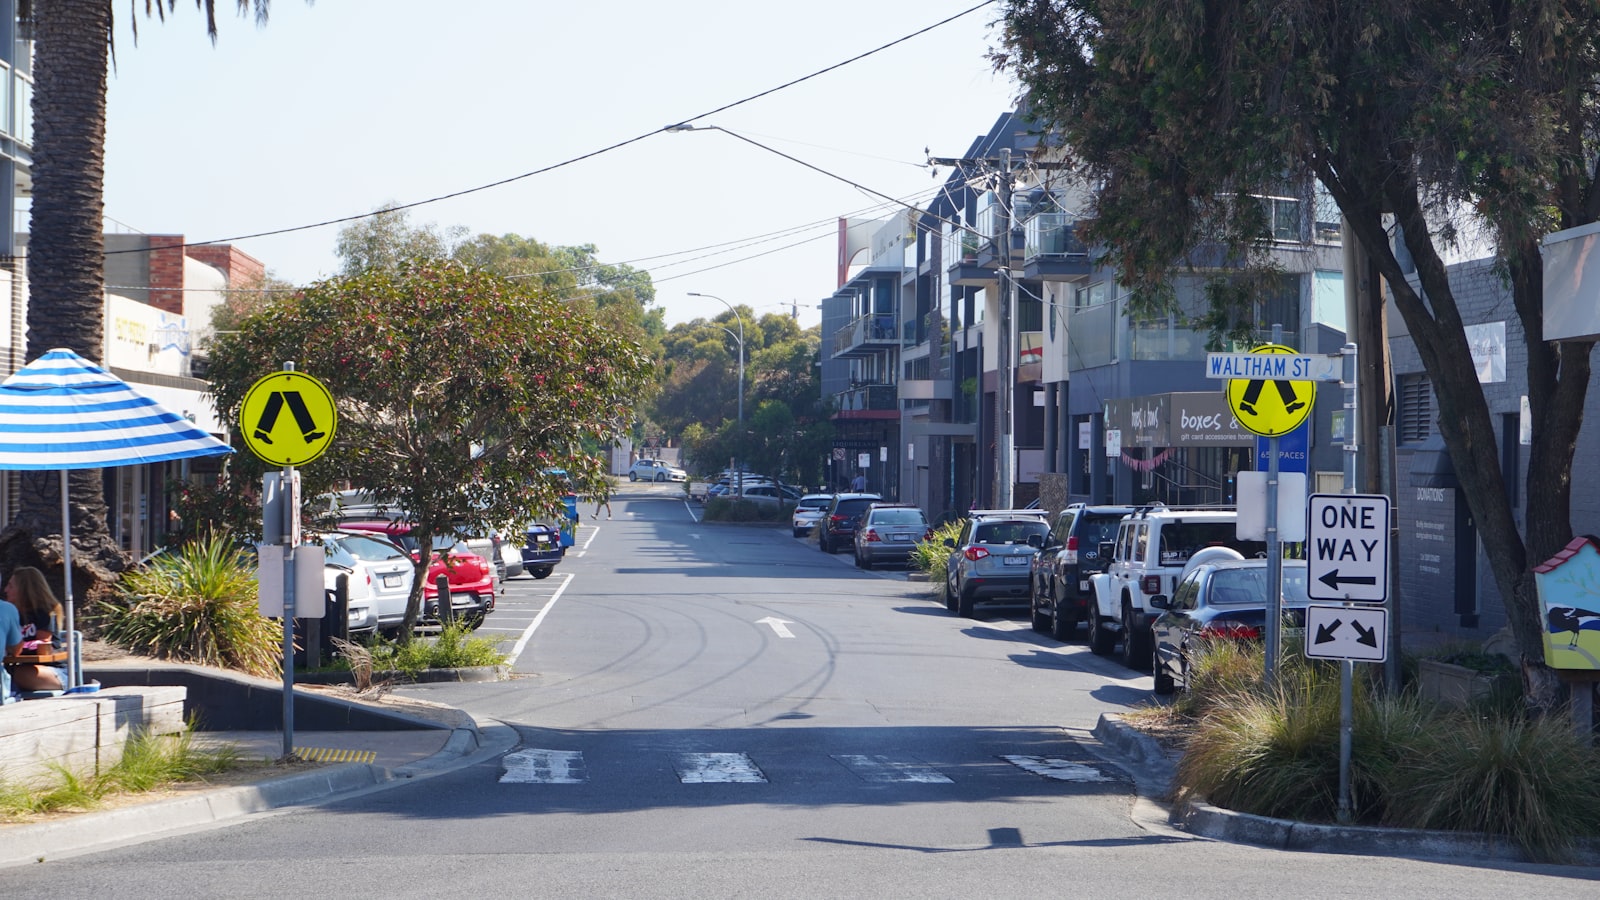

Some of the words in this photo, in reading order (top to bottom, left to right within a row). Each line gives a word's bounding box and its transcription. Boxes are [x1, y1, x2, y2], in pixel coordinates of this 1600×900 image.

[1211, 356, 1286, 377] WALTHAM
[1292, 357, 1311, 378] ST
[1180, 408, 1222, 431] boxes
[1229, 414, 1239, 429] &
[1180, 433, 1190, 441] gift
[1278, 451, 1305, 460] PACES
[1416, 488, 1445, 502] DONATIONS
[1321, 505, 1376, 529] ONE
[1317, 537, 1379, 562] WAY
